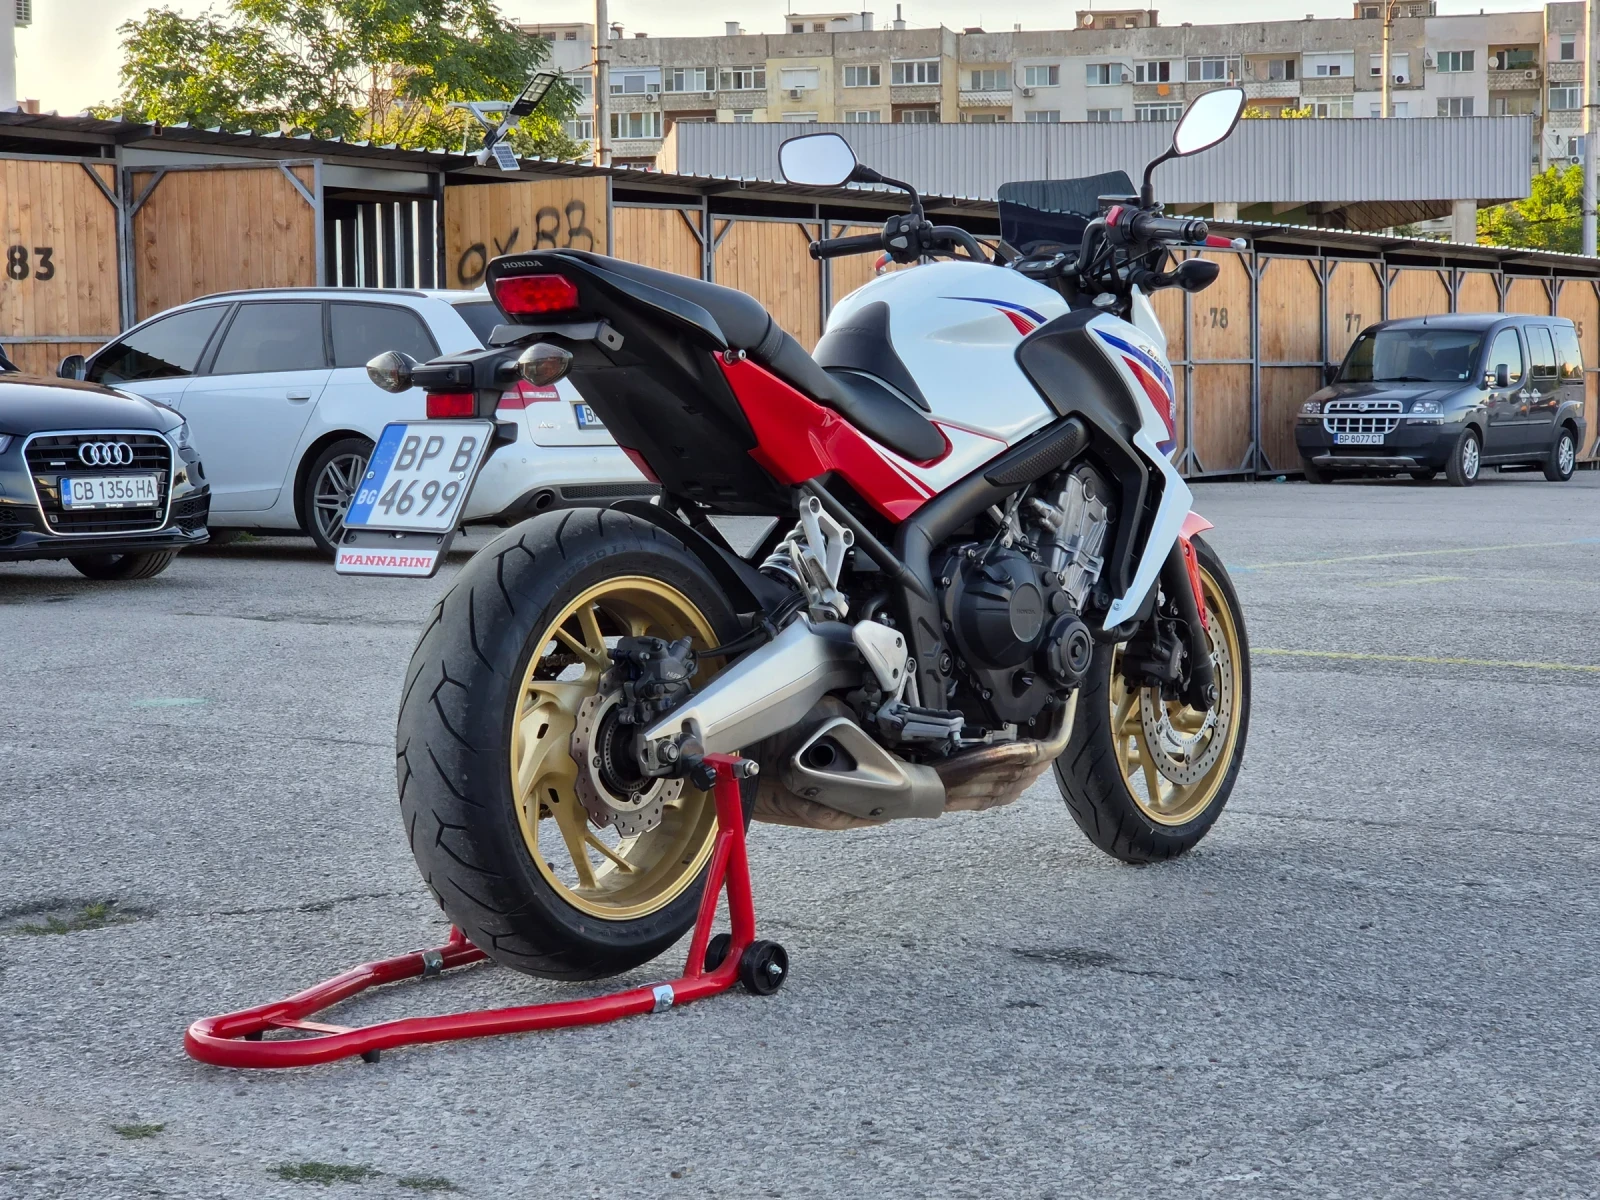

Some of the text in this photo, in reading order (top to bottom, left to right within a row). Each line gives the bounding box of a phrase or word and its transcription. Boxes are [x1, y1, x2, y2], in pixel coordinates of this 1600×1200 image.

[6, 245, 55, 281] 83
[502, 260, 543, 269] HONDA
[1210, 307, 1229, 329] 78
[1345, 313, 1362, 333] 77
[1573, 321, 1583, 339] 5
[1339, 434, 1383, 444] BP 8077 CT
[394, 435, 477, 472] BP B
[73, 479, 155, 501] CB 1356 HA
[356, 489, 378, 505] BG
[377, 479, 460, 518] 4699
[339, 554, 433, 569] MANNARINI
